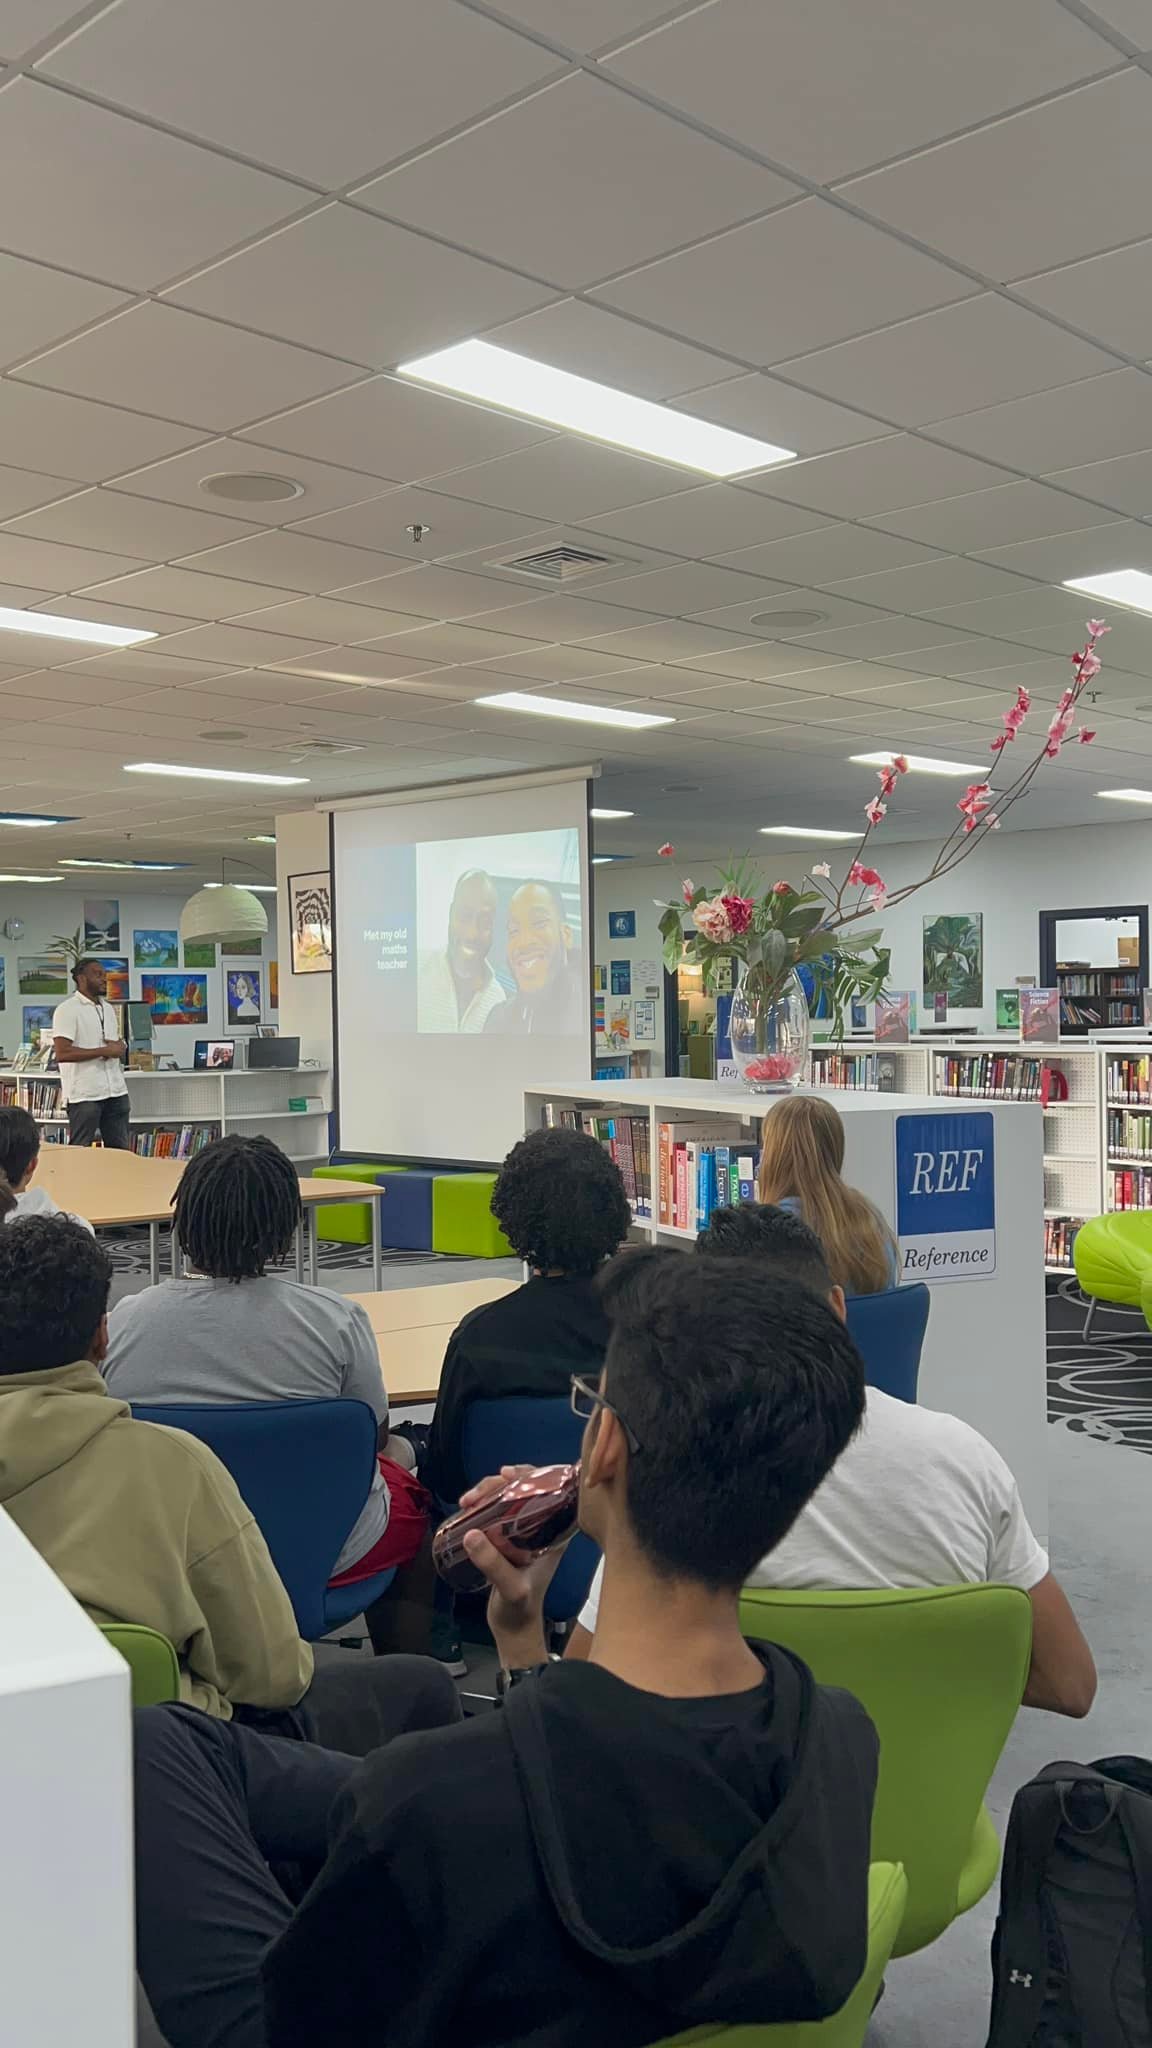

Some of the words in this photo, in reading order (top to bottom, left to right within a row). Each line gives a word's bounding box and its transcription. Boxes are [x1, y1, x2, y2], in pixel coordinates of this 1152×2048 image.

[363, 929, 380, 941] Met
[380, 930, 393, 942] my
[394, 927, 407, 939] old
[382, 944, 407, 954] maths
[377, 958, 407, 969] teacher
[909, 1149, 984, 1195] REF
[904, 1247, 988, 1271] Reference
